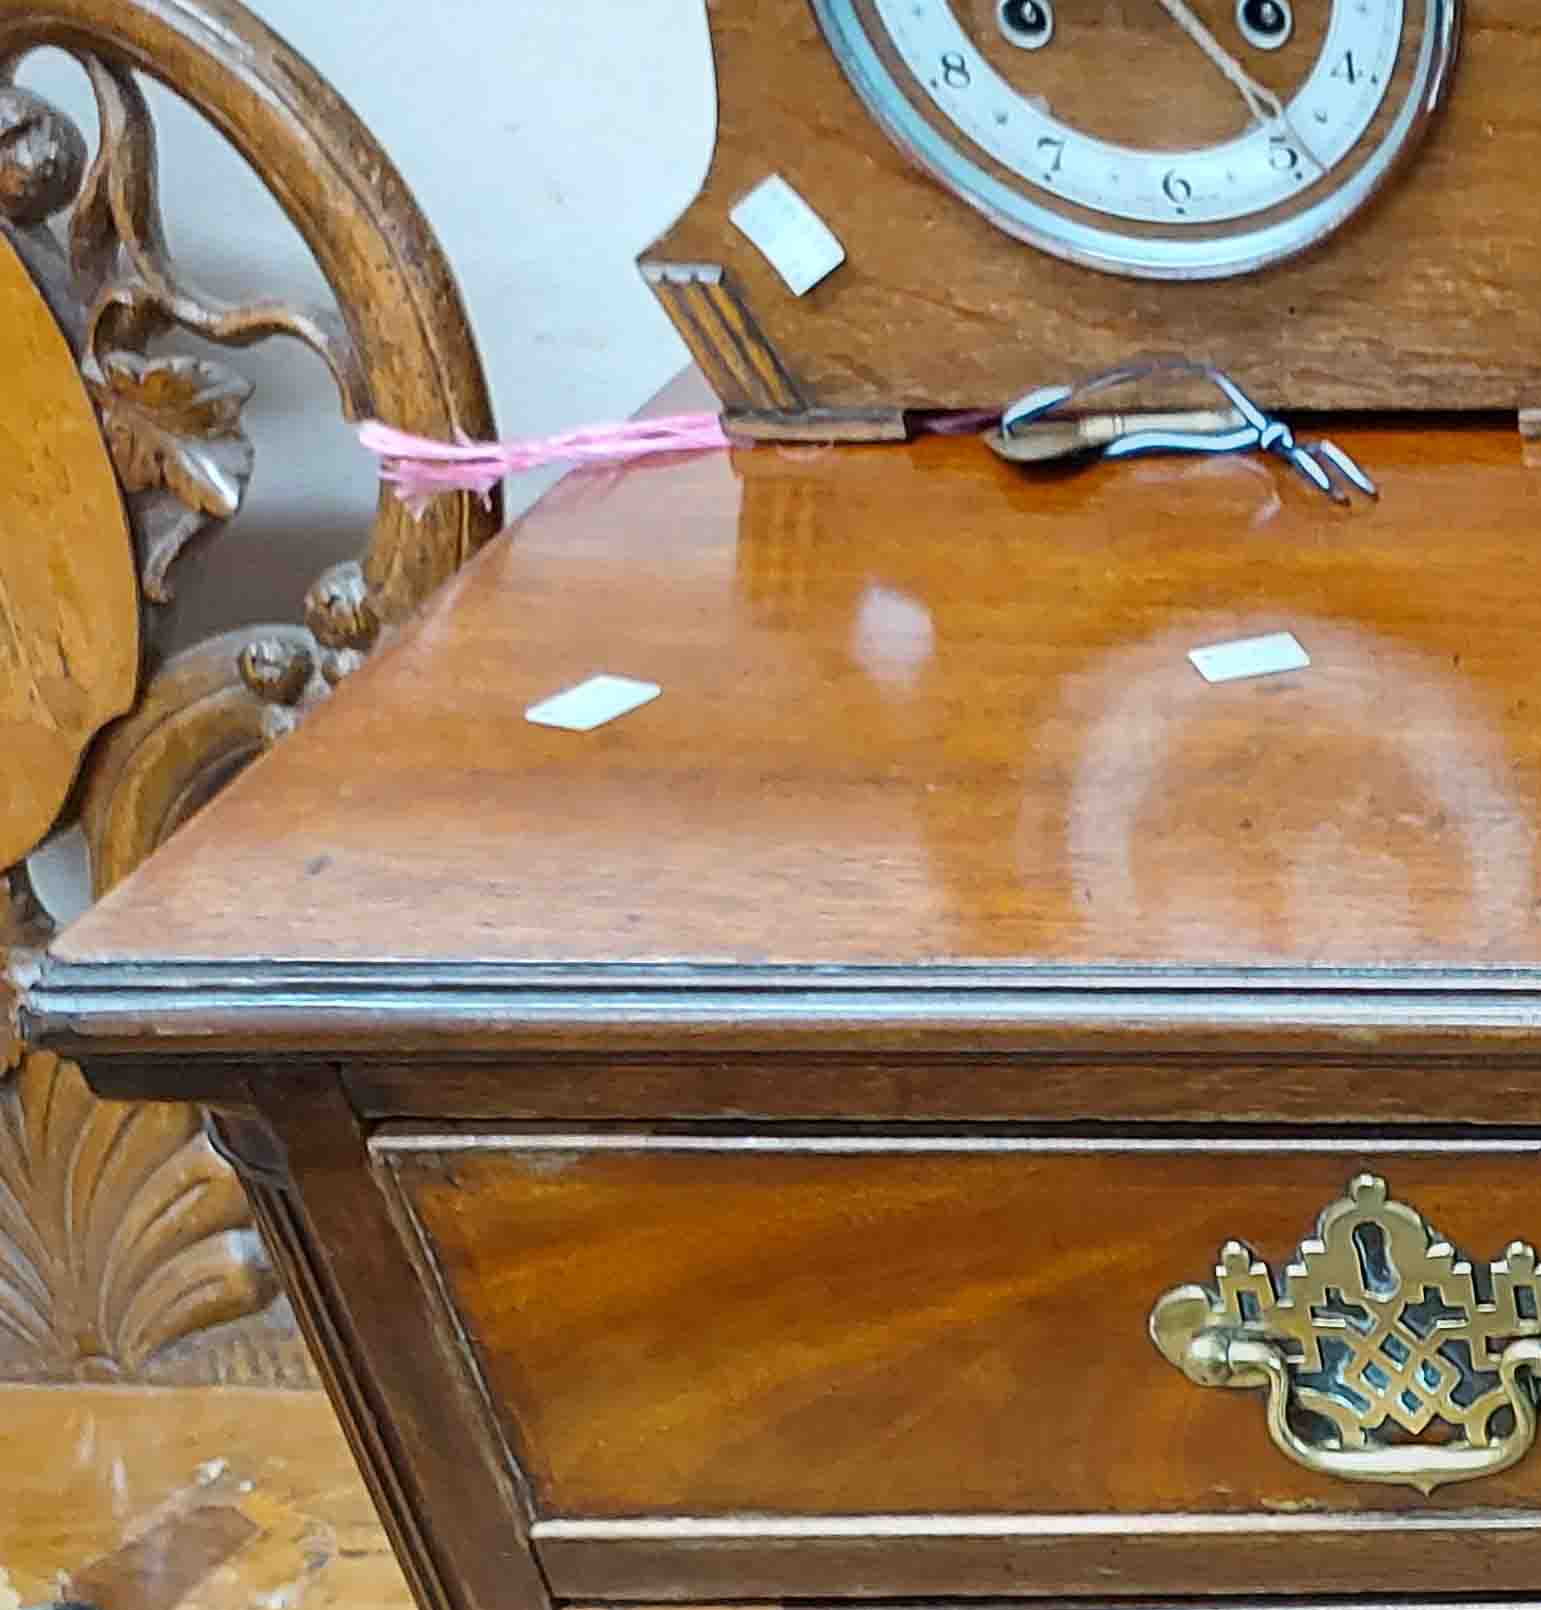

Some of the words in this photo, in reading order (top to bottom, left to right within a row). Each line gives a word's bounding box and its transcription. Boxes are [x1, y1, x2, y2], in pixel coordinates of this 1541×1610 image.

[941, 53, 970, 88] 8
[1331, 51, 1363, 84] 4
[1038, 137, 1065, 171] 7
[1269, 136, 1298, 169] 5
[1162, 169, 1192, 203] 6
